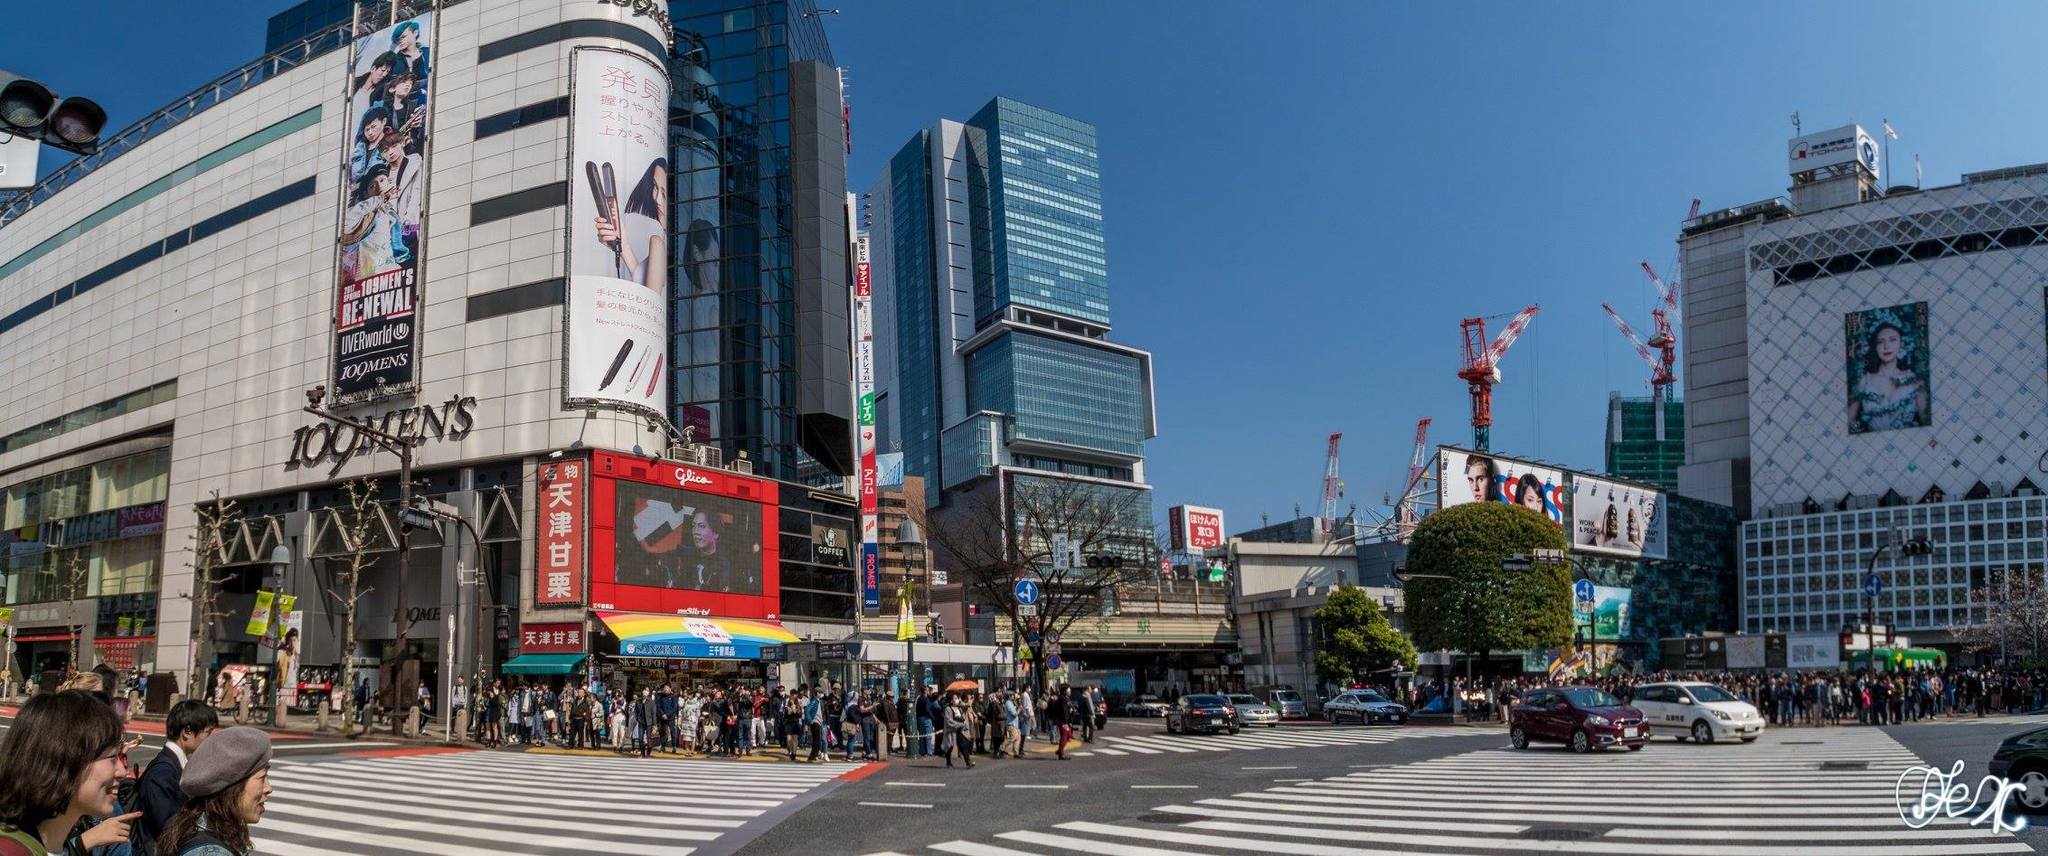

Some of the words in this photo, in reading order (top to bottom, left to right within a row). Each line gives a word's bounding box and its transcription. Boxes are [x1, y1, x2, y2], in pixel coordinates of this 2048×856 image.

[361, 268, 414, 297] 109MEN'S
[859, 271, 869, 296] アイフル
[342, 286, 412, 326] RE:NEWAL
[341, 323, 393, 355] UVERworld
[340, 352, 409, 382] 109MEN'S
[862, 397, 872, 422] レイク
[284, 394, 478, 479] 109MEN'S
[544, 464, 579, 481] 名物
[675, 467, 713, 485] Glico
[864, 468, 874, 495] アコム
[1190, 514, 1218, 527] ほけんの
[1579, 519, 1595, 527] WORK
[548, 482, 573, 599] 天津甘栗
[818, 545, 844, 556] COFFEE
[1195, 538, 1217, 547] グループ
[866, 553, 876, 590] PROMISE
[524, 630, 580, 646] 天津甘栗
